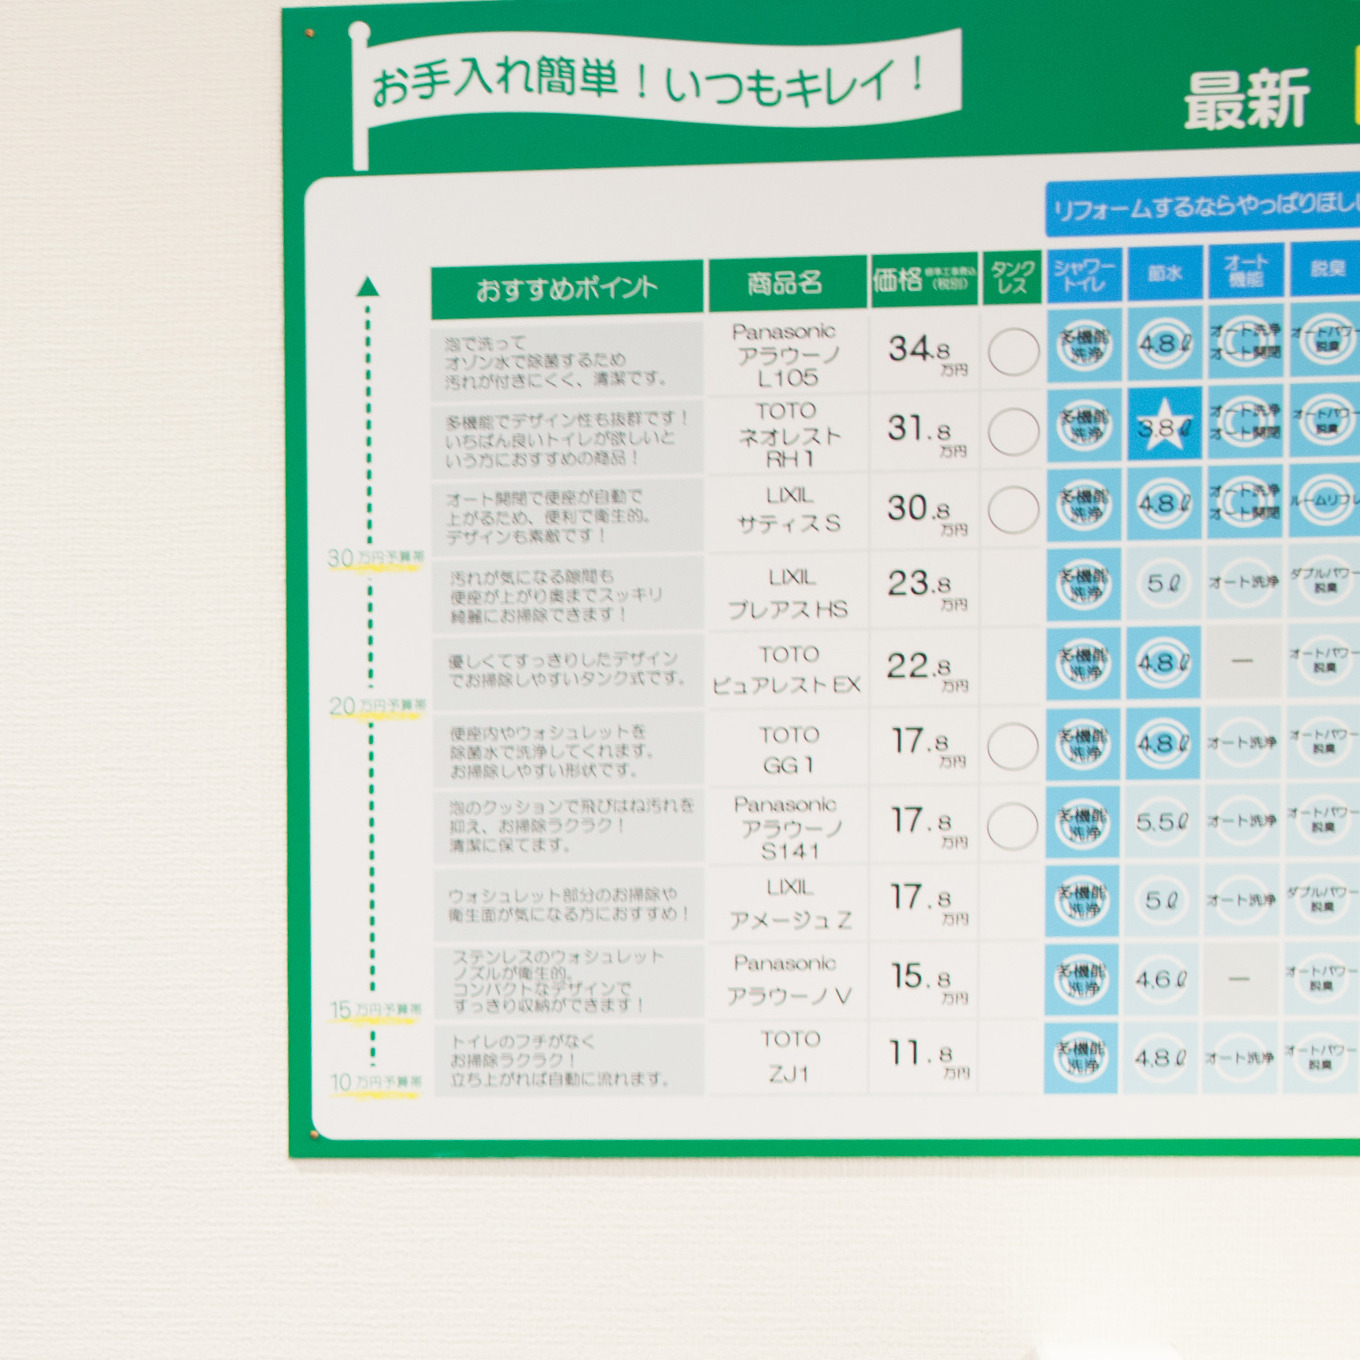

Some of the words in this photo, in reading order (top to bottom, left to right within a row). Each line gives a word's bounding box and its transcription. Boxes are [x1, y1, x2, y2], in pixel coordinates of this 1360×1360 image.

[1182, 66, 1313, 131] 最新
[990, 259, 1036, 278] タンク
[1053, 258, 1116, 278] シャワー
[1223, 253, 1269, 270] オート
[1310, 259, 1347, 278] 脱臭
[871, 266, 924, 292] 価格
[1147, 263, 1183, 282] 節水
[1228, 269, 1265, 288] 機能
[476, 274, 659, 303] おすすめポイント
[747, 269, 823, 296] 商品名
[998, 277, 1028, 294] レス
[1064, 275, 1106, 292] トイレ
[732, 323, 837, 341] Panasonic
[737, 346, 841, 366] アラウーノ
[888, 334, 951, 362] 34.8
[757, 369, 819, 388] L105
[939, 363, 969, 378] 万円
[754, 402, 817, 419] TOTO
[887, 413, 952, 440] 31.8
[738, 425, 842, 447] ネオレスト
[938, 444, 968, 459] 万円
[765, 486, 815, 504] LIXIL
[886, 493, 951, 521] 30.8
[939, 522, 969, 537] 万円
[768, 568, 817, 585] LIXIL
[887, 569, 952, 597] 23.8
[939, 598, 969, 612] 万円
[758, 645, 821, 663] TOTO
[886, 651, 952, 679] 22.8
[941, 679, 970, 694] 万円
[758, 725, 821, 743] TOTO
[891, 726, 950, 754] 17.8
[938, 754, 967, 769] 万円
[733, 795, 838, 813] Panasonic
[890, 805, 953, 833] 17.8
[741, 818, 844, 839] アラウーノ
[760, 841, 820, 860] S141
[940, 835, 969, 850] 万円
[765, 877, 815, 895] LIXIL
[890, 882, 952, 910] 17.8
[941, 911, 970, 926] 万円
[733, 954, 837, 972] Panasonic
[891, 961, 952, 989] 15.8
[941, 989, 970, 1005] 万円
[760, 1029, 822, 1047] TOTO
[888, 1038, 953, 1066] 11.8
[768, 1065, 810, 1083] ZJ1
[943, 1065, 972, 1080] 万円
